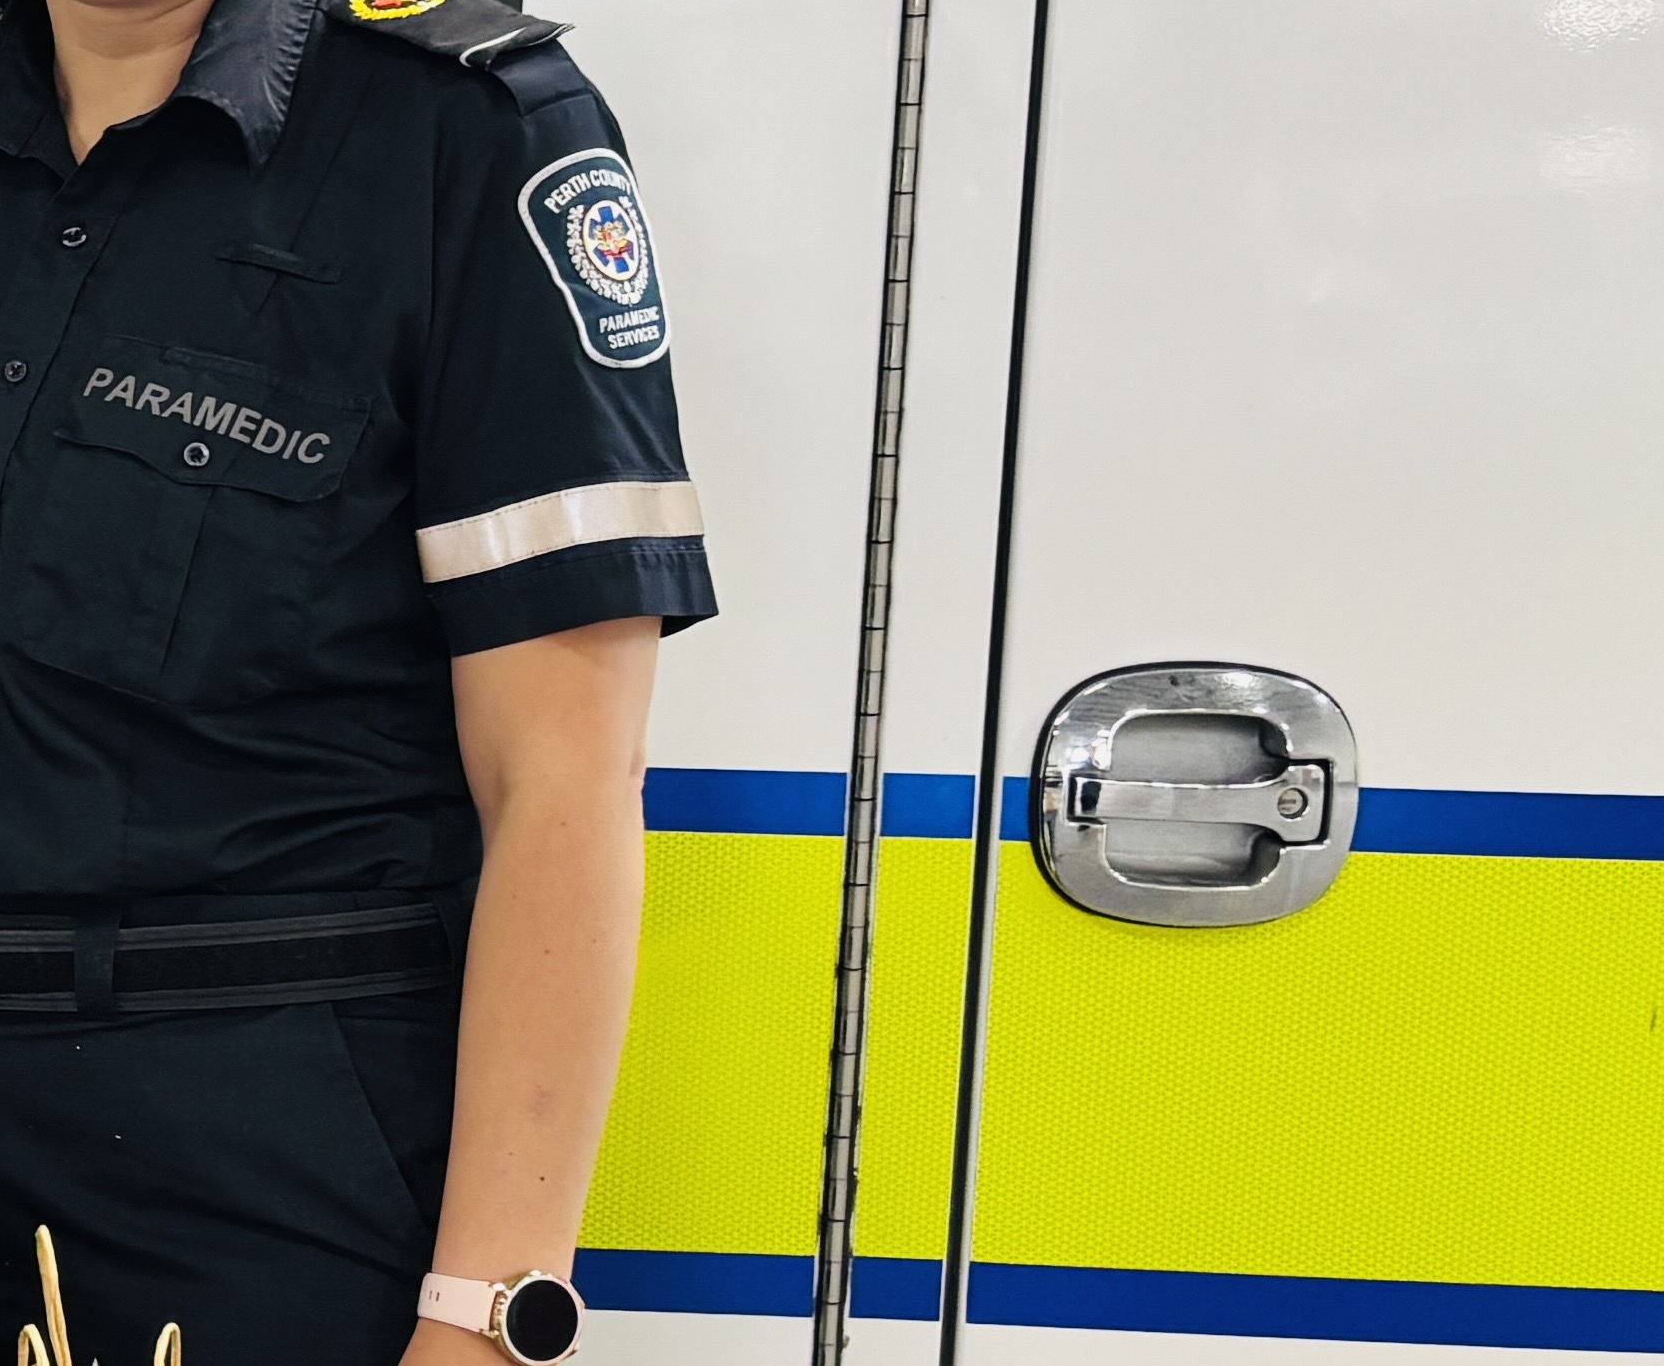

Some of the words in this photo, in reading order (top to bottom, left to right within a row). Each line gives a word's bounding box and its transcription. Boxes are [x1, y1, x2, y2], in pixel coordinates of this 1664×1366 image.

[544, 173, 589, 213] PERTH
[589, 169, 633, 194] COUNTY
[599, 305, 660, 333] PARAMEDIC
[608, 325, 660, 349] SERVICES
[83, 368, 331, 464] PARAMEDIC
